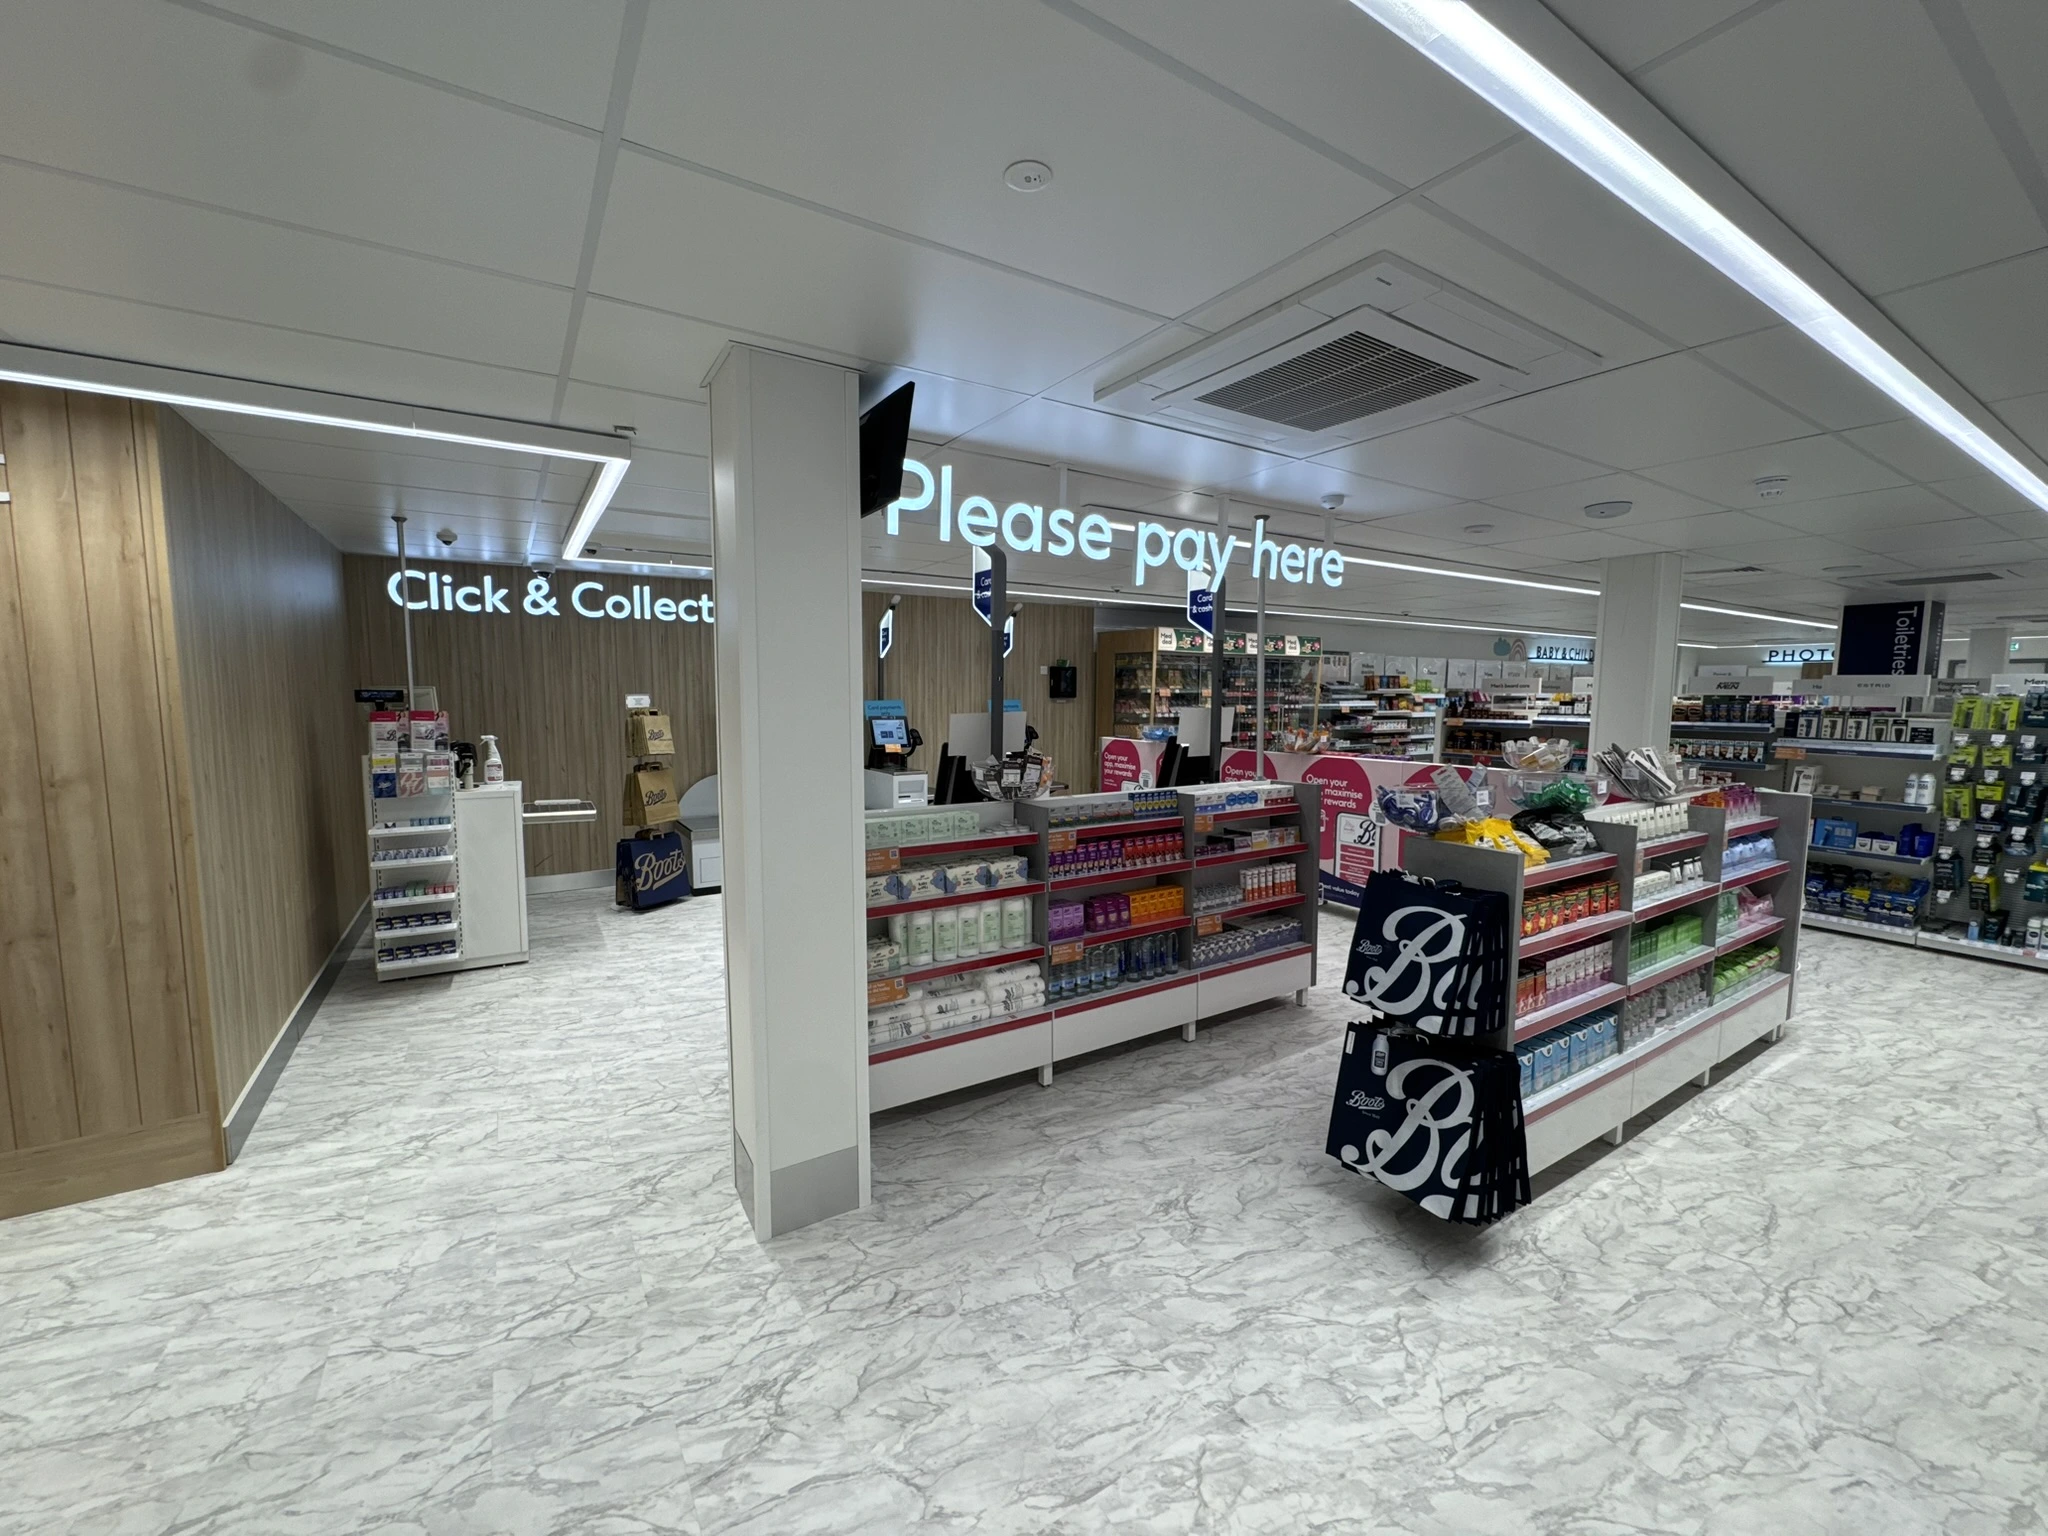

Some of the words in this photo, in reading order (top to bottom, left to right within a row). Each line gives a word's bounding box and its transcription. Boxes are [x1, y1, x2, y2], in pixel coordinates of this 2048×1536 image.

[886, 457, 1113, 561] Please
[1134, 520, 1237, 593] pay
[1252, 518, 1345, 588] here
[387, 569, 511, 613] Click
[522, 578, 561, 617] &
[571, 581, 715, 624] Collect
[1197, 593, 1213, 603] Card
[1192, 605, 1198, 614] &
[1891, 605, 1918, 676] Toiletries
[1536, 645, 1559, 659] BABY
[1562, 647, 1567, 659] &
[1568, 648, 1595, 661] CHILD
[1768, 648, 1835, 662] PHOT
[879, 705, 902, 713] payments
[647, 728, 665, 741] Boots
[1104, 751, 1117, 761] Open
[1114, 762, 1137, 771] maximise
[1225, 765, 1244, 777] Open
[1244, 770, 1257, 778] you
[1114, 770, 1133, 778] rewards
[1306, 773, 1329, 787] Open
[1329, 779, 1349, 788] your
[644, 788, 668, 806] Boots
[1324, 787, 1364, 800] maximise
[1323, 797, 1357, 809] rewards
[634, 848, 688, 892] Boots
[1332, 885, 1345, 893] value
[1345, 886, 1360, 897] today
[1355, 939, 1383, 955] Boots
[1345, 1089, 1385, 1111] Boots
